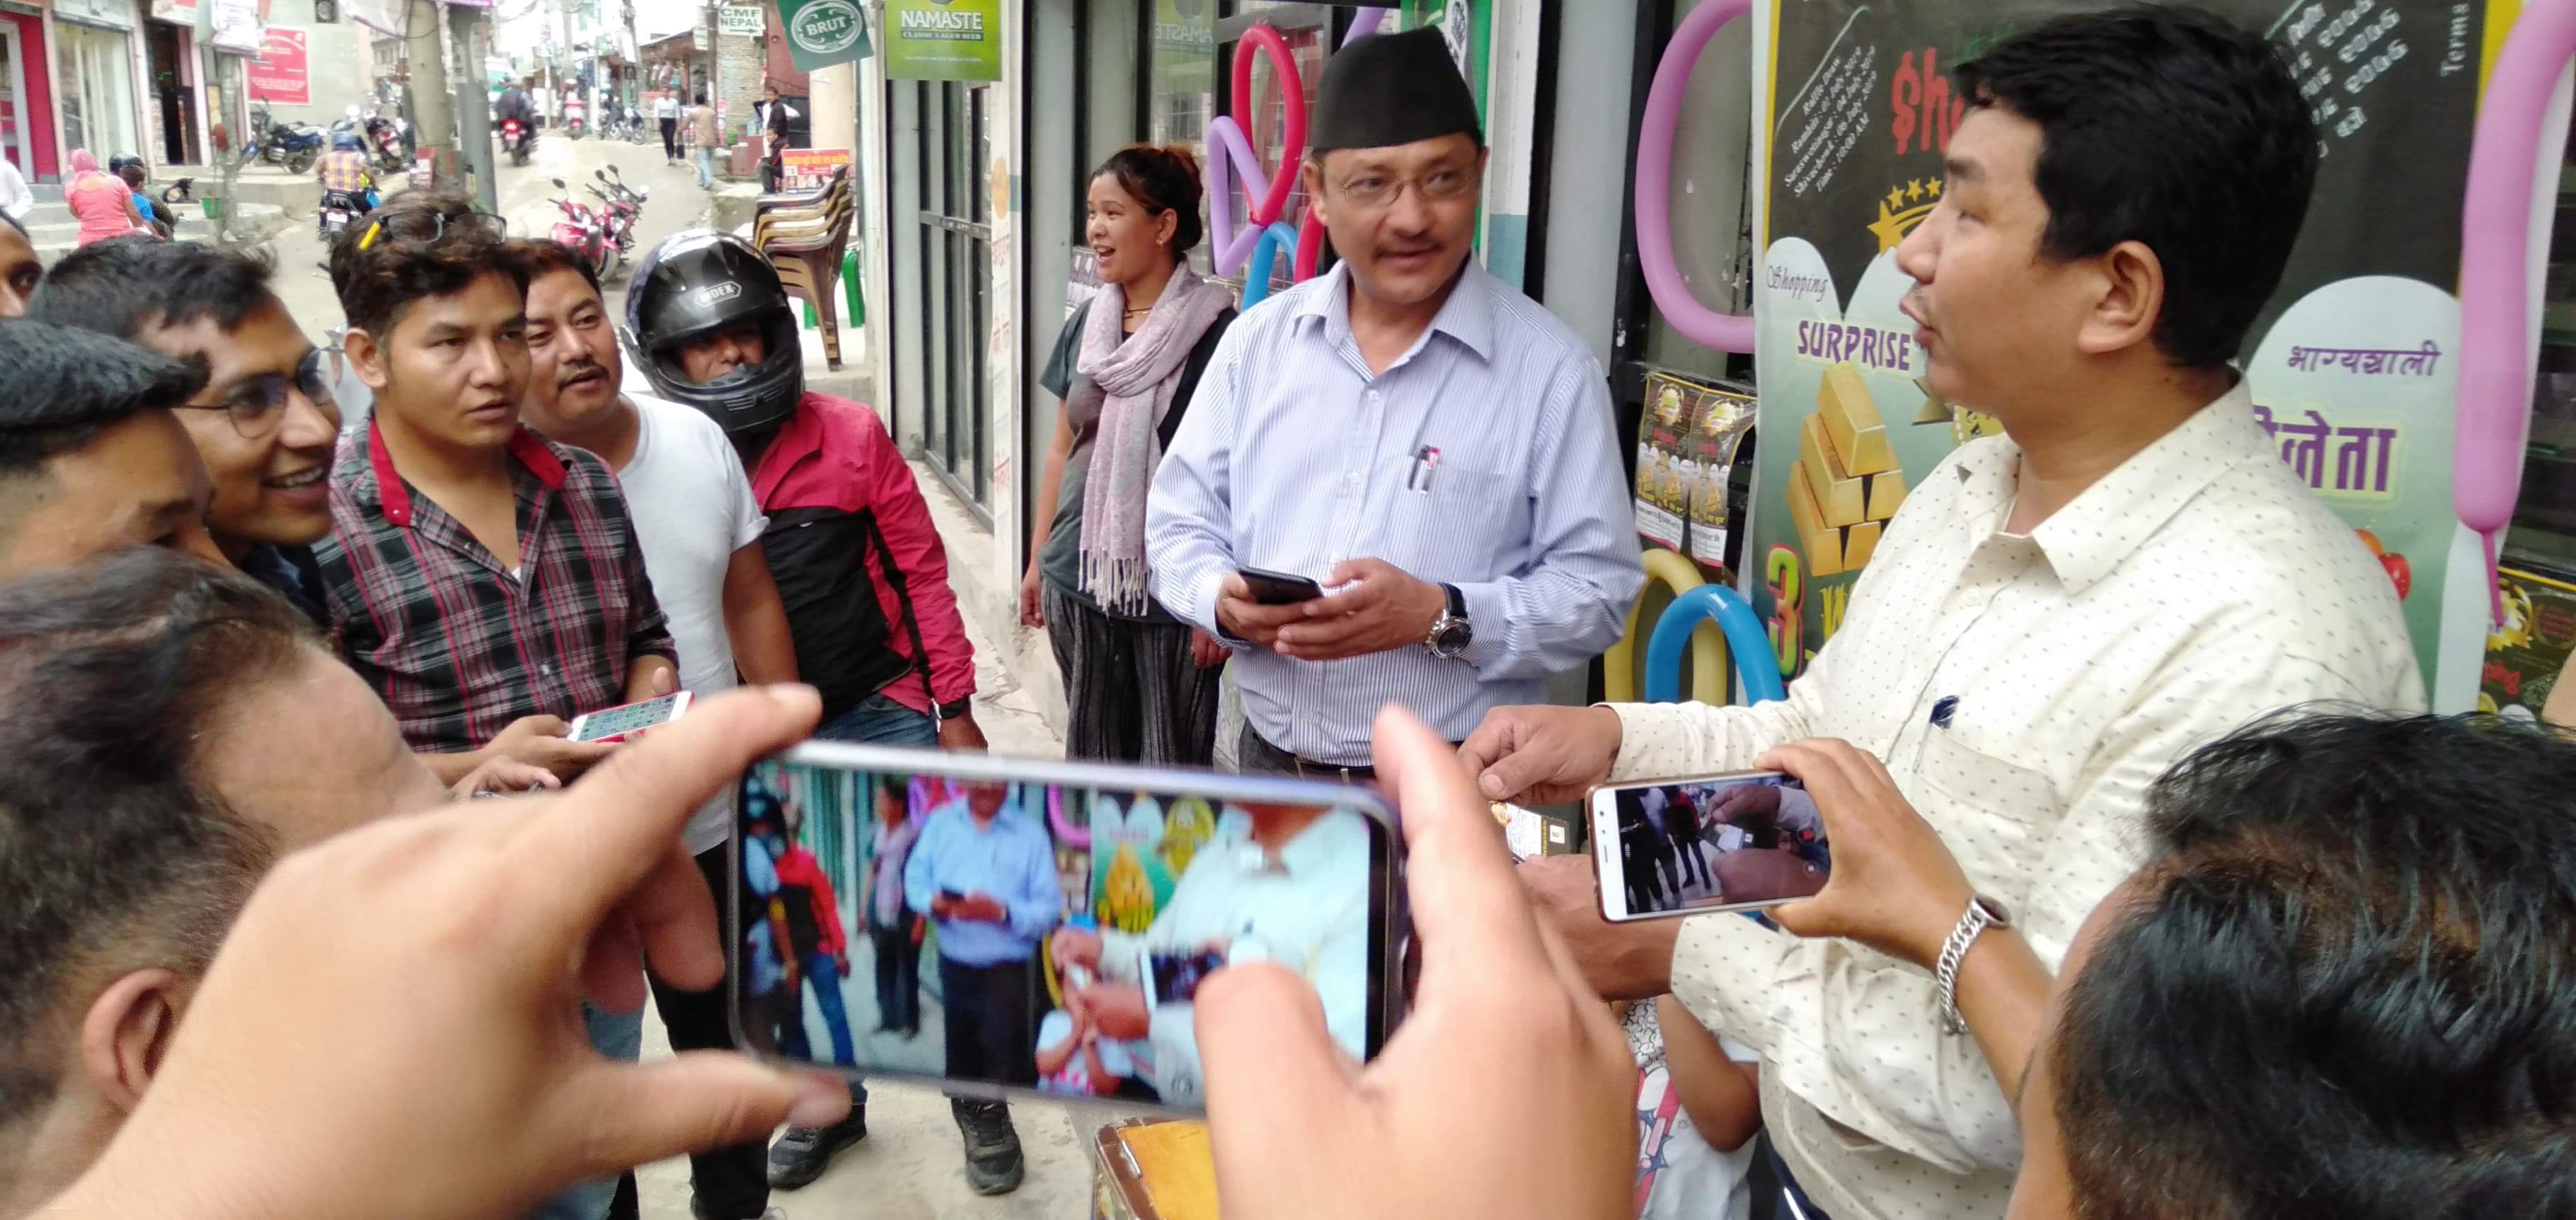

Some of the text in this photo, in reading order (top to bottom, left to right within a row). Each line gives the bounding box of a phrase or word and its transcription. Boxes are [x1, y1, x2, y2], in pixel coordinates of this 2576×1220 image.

[720, 8, 761, 18] CMF
[720, 18, 761, 27] NEPAL
[901, 10, 983, 30] NAMASTE
[805, 16, 847, 36] BRUT
[1766, 265, 1829, 302] Shopping
[1797, 320, 1911, 371] SURPRISE
